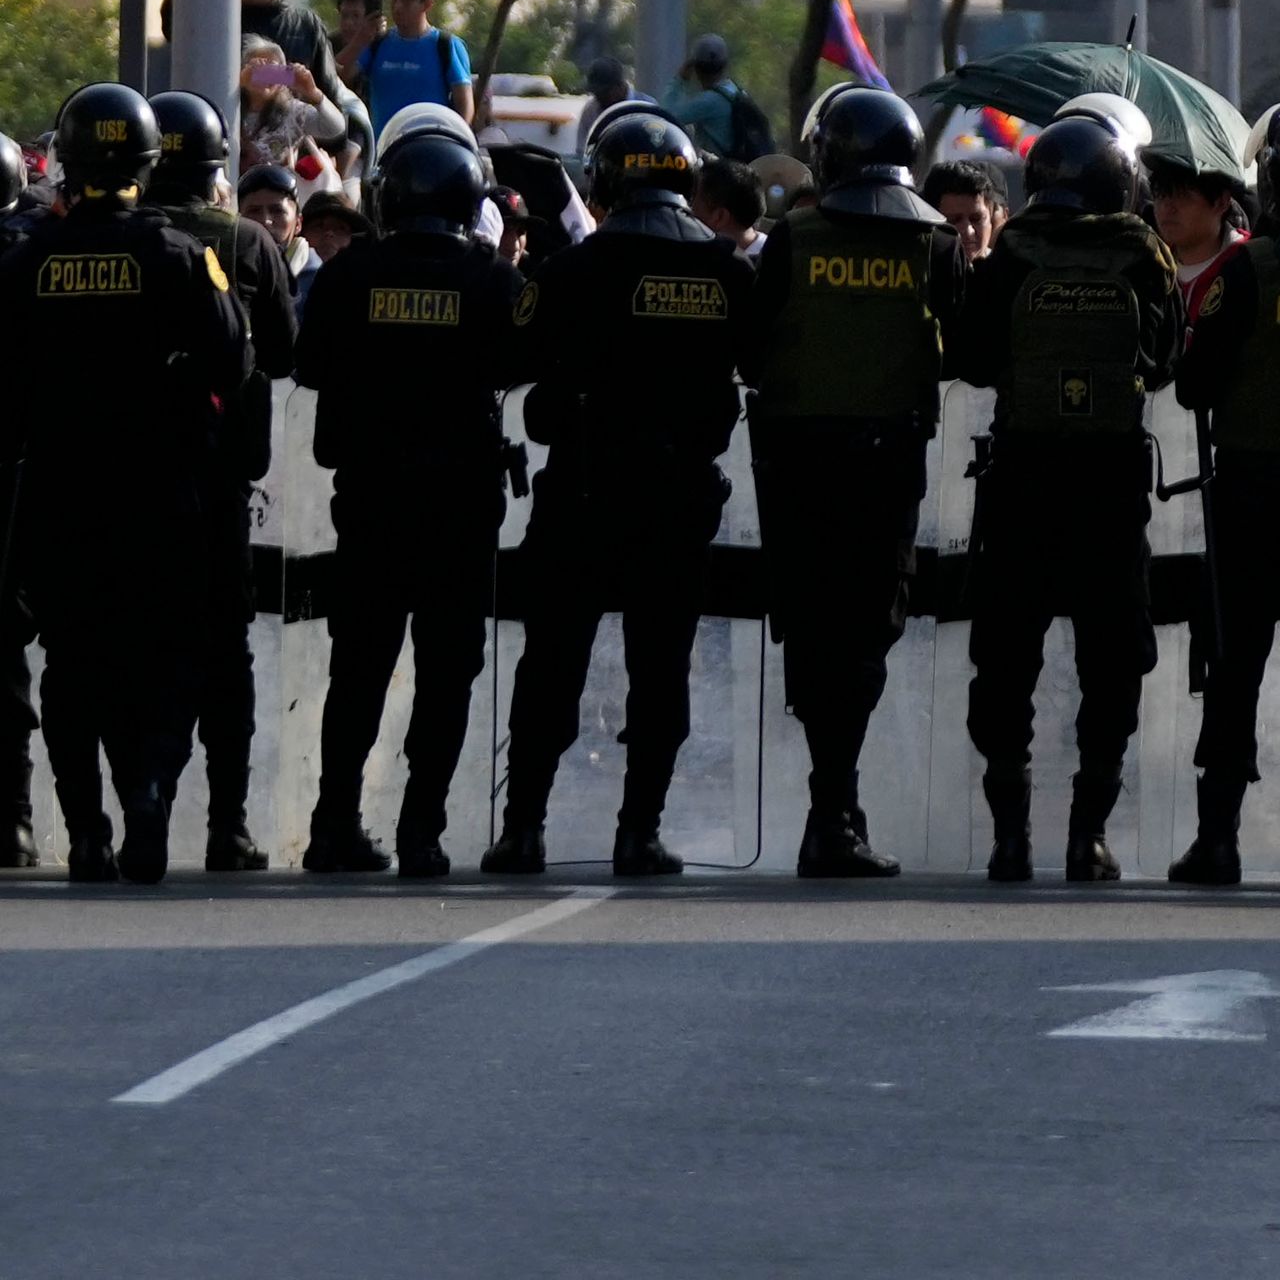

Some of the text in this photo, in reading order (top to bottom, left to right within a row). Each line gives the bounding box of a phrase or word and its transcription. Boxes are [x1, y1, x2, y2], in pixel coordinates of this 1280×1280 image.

[96, 120, 127, 142] USE
[161, 133, 183, 151] SE
[624, 154, 687, 171] PELAO
[50, 262, 133, 291] POLICIA
[809, 256, 914, 289] POLICIA
[643, 281, 722, 304] POLICIA
[1041, 283, 1118, 298] Policia
[374, 295, 458, 322] POLICIA
